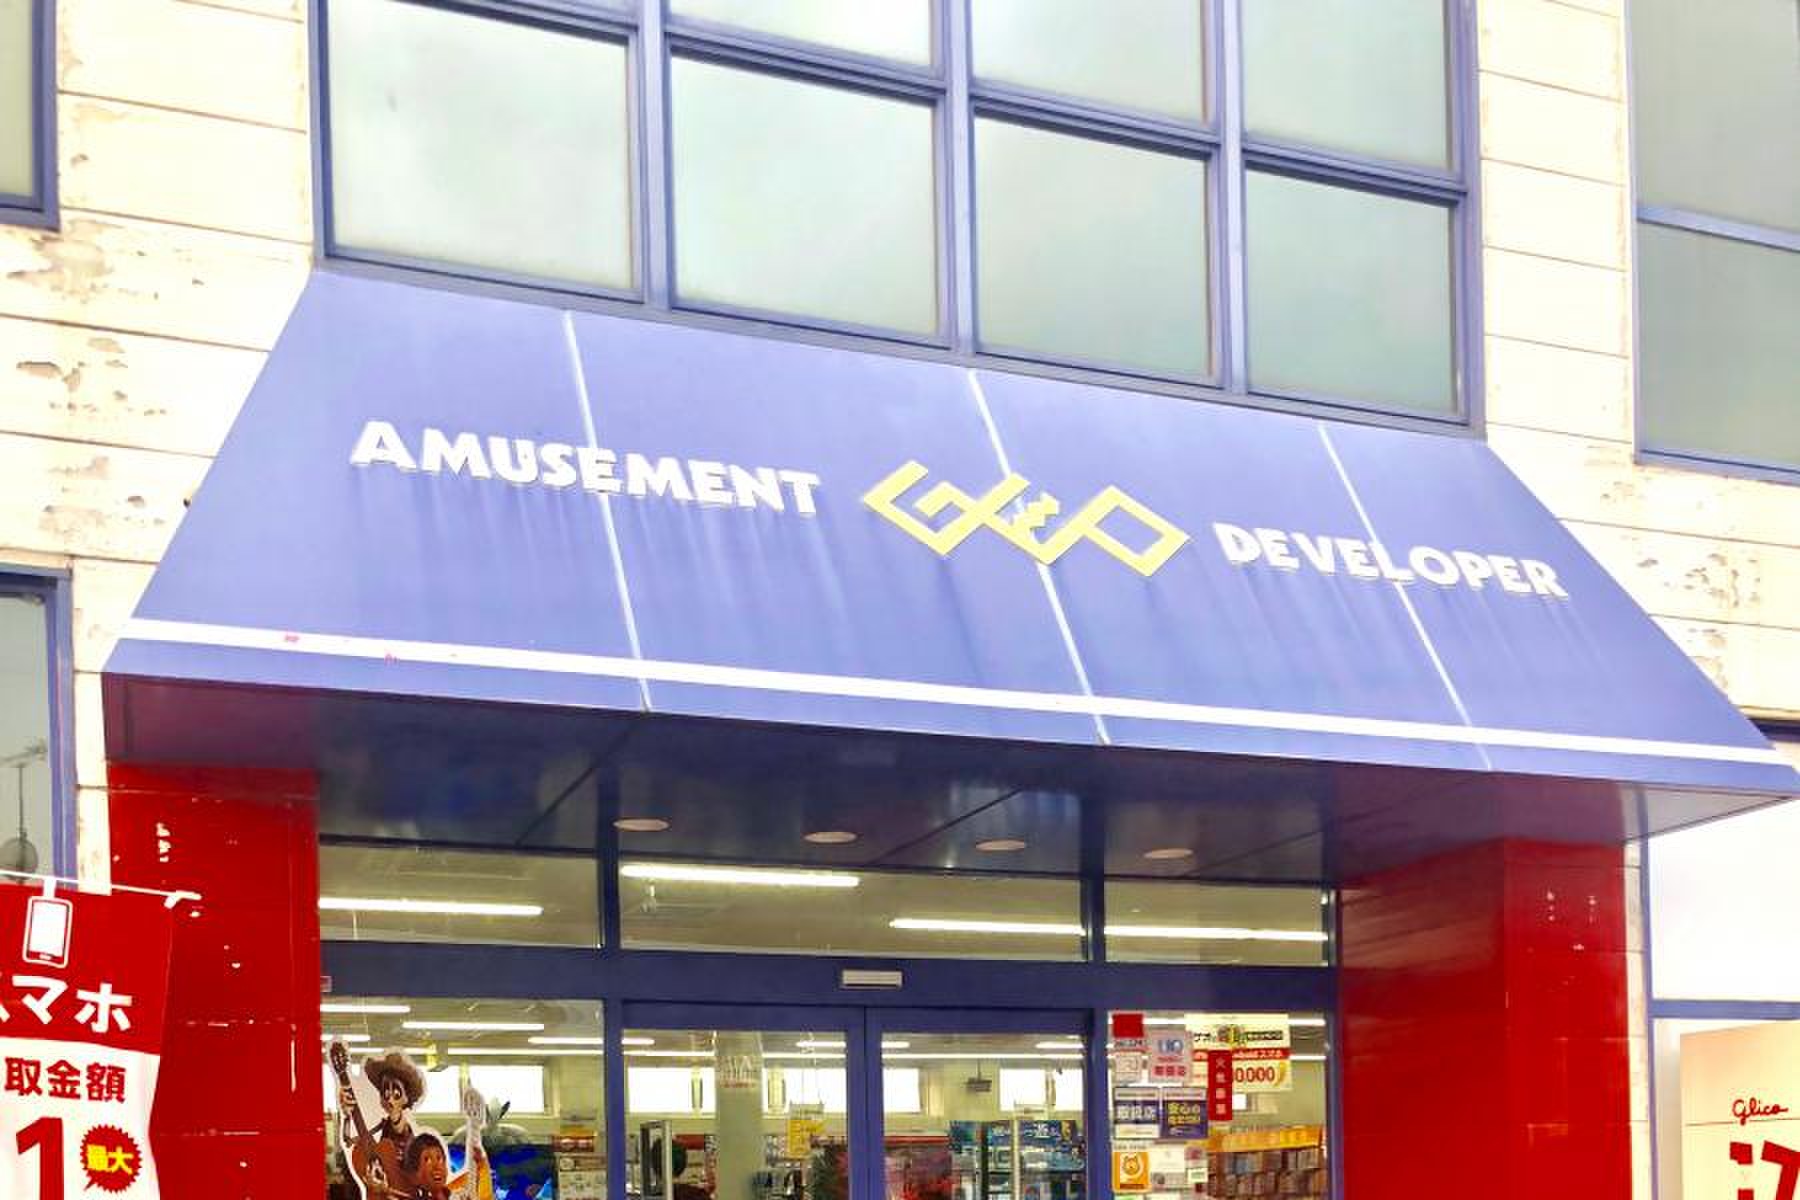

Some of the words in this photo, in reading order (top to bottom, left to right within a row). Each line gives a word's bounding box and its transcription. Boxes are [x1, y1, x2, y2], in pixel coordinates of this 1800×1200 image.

[350, 420, 820, 515] AMUSEMENT
[1212, 521, 1569, 599] DEVELOPER
[0, 973, 133, 1034] マホ
[4, 1056, 127, 1104] 取金額
[86, 1144, 134, 1174] 最大
